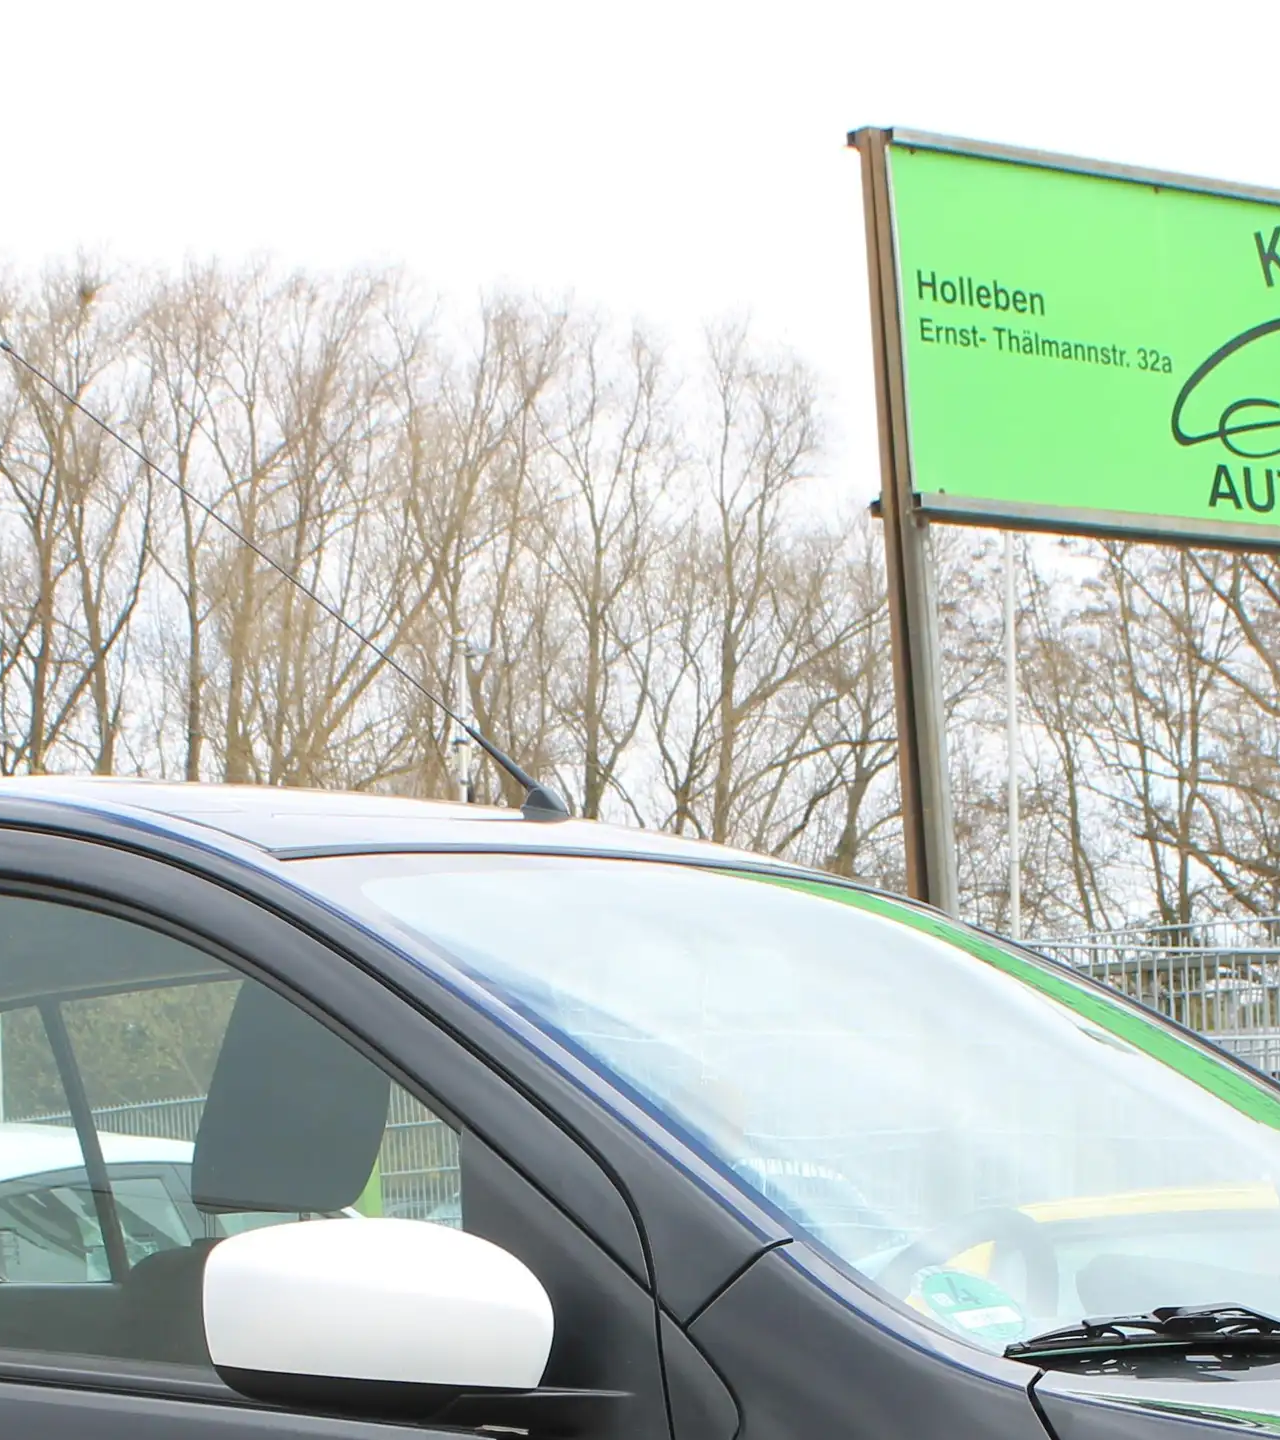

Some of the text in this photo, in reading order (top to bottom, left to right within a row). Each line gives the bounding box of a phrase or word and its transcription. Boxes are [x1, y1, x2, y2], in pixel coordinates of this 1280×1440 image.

[916, 269, 1045, 316] Holleben
[919, 317, 1173, 374] Ernst- Thälmannstr. 32a
